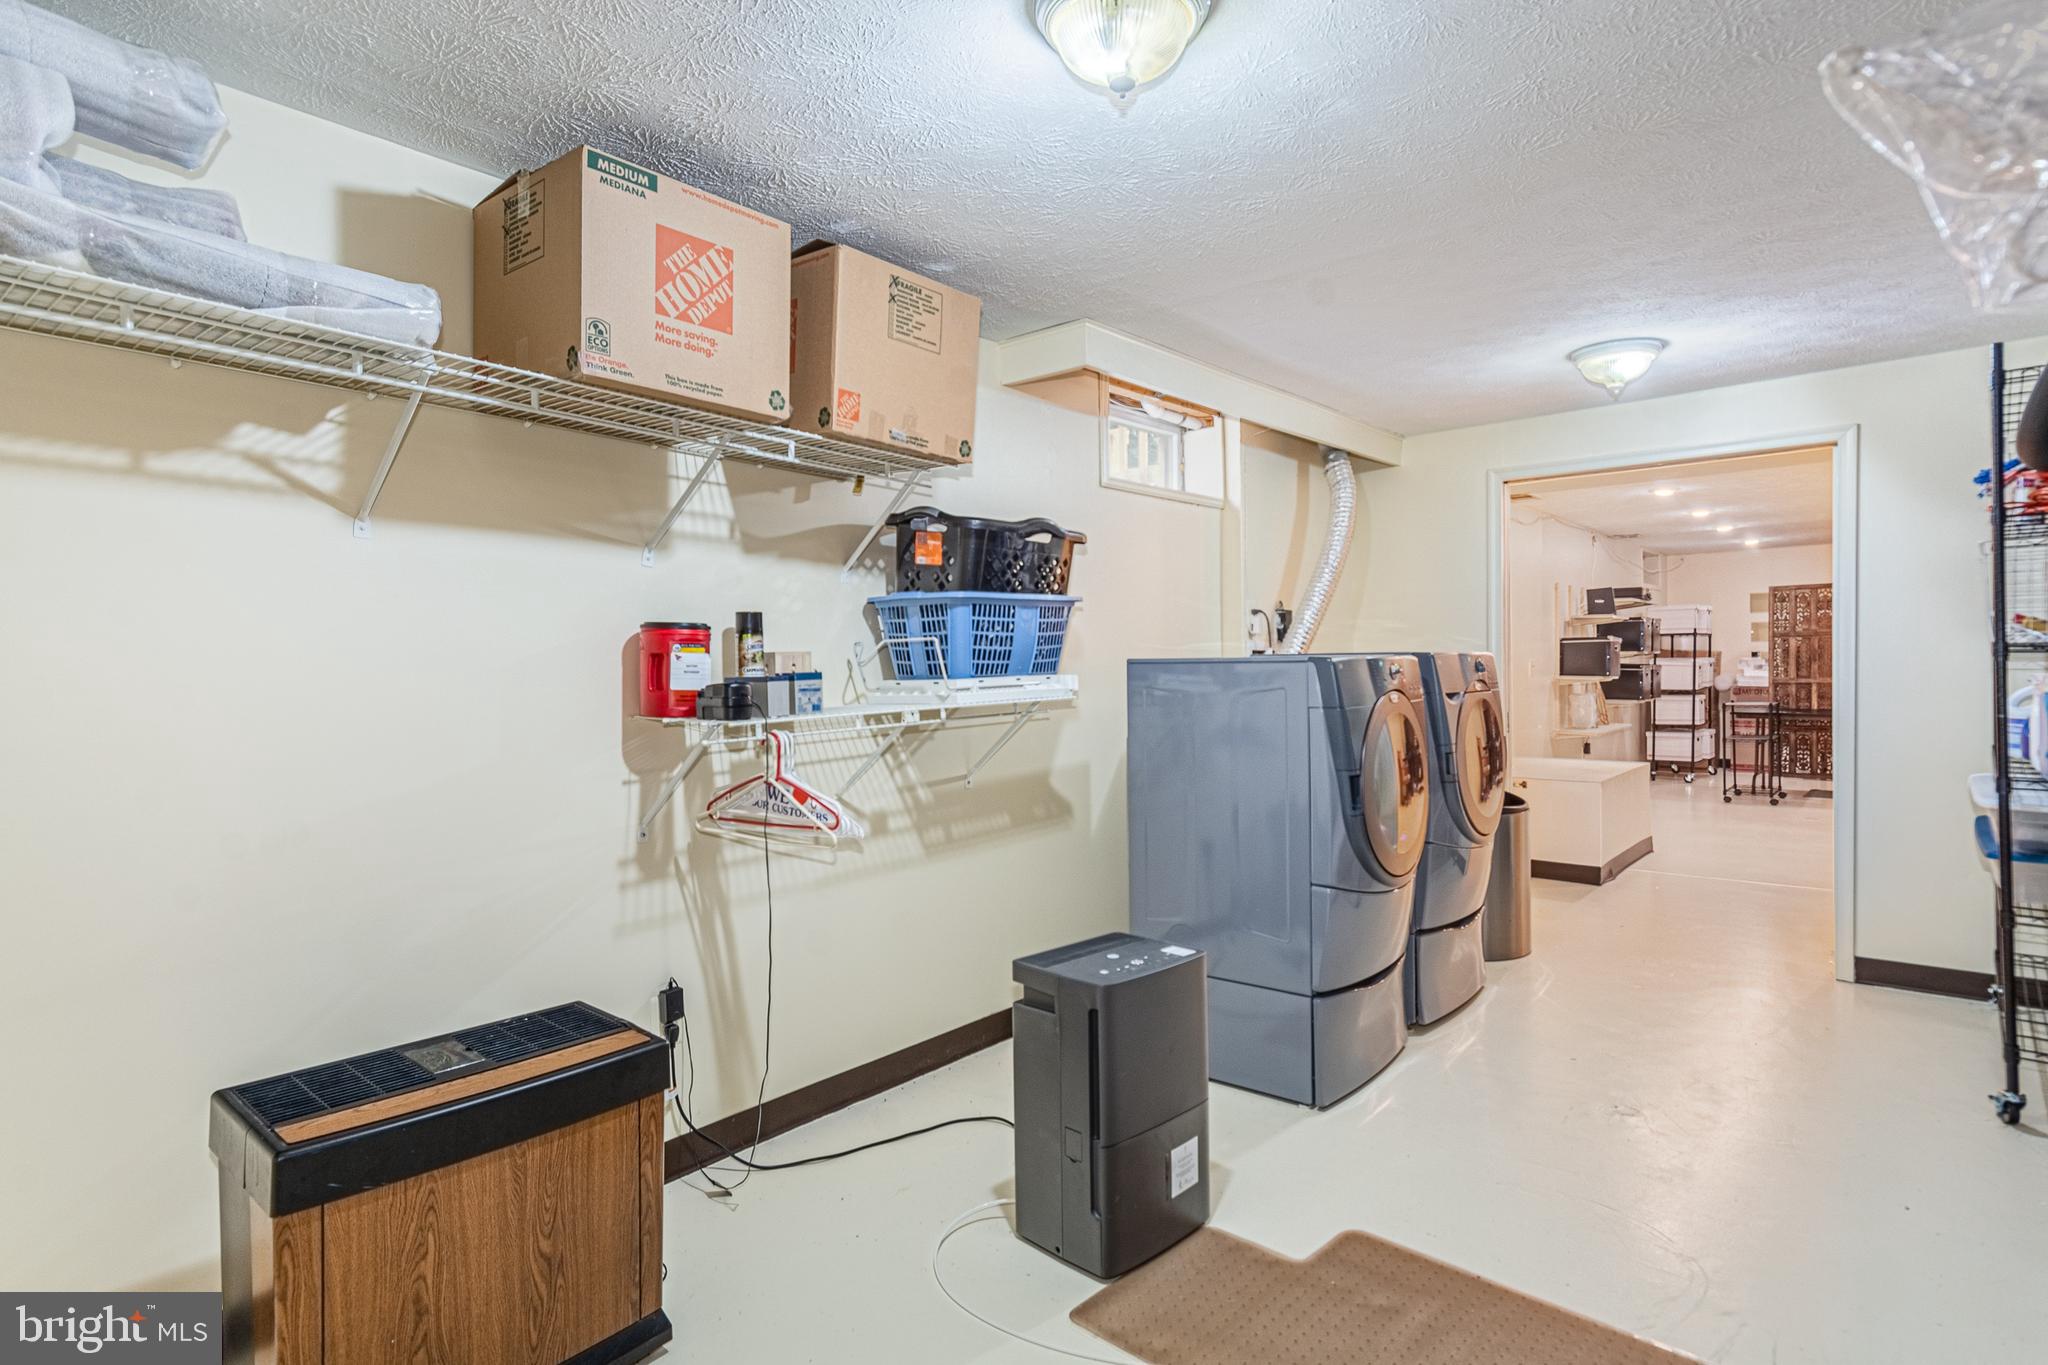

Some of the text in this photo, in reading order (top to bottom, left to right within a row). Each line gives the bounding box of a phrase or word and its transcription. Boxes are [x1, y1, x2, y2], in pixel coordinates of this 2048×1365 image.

[597, 158, 649, 187] MEDIUM
[599, 175, 647, 199] MEDIANA
[663, 242, 697, 274] THE
[655, 245, 734, 319] HOME
[686, 279, 734, 325] DEPOT
[587, 335, 609, 348] ECO
[655, 320, 719, 347] More saving.
[655, 332, 682, 348] More
[585, 361, 635, 378] Think Green.
